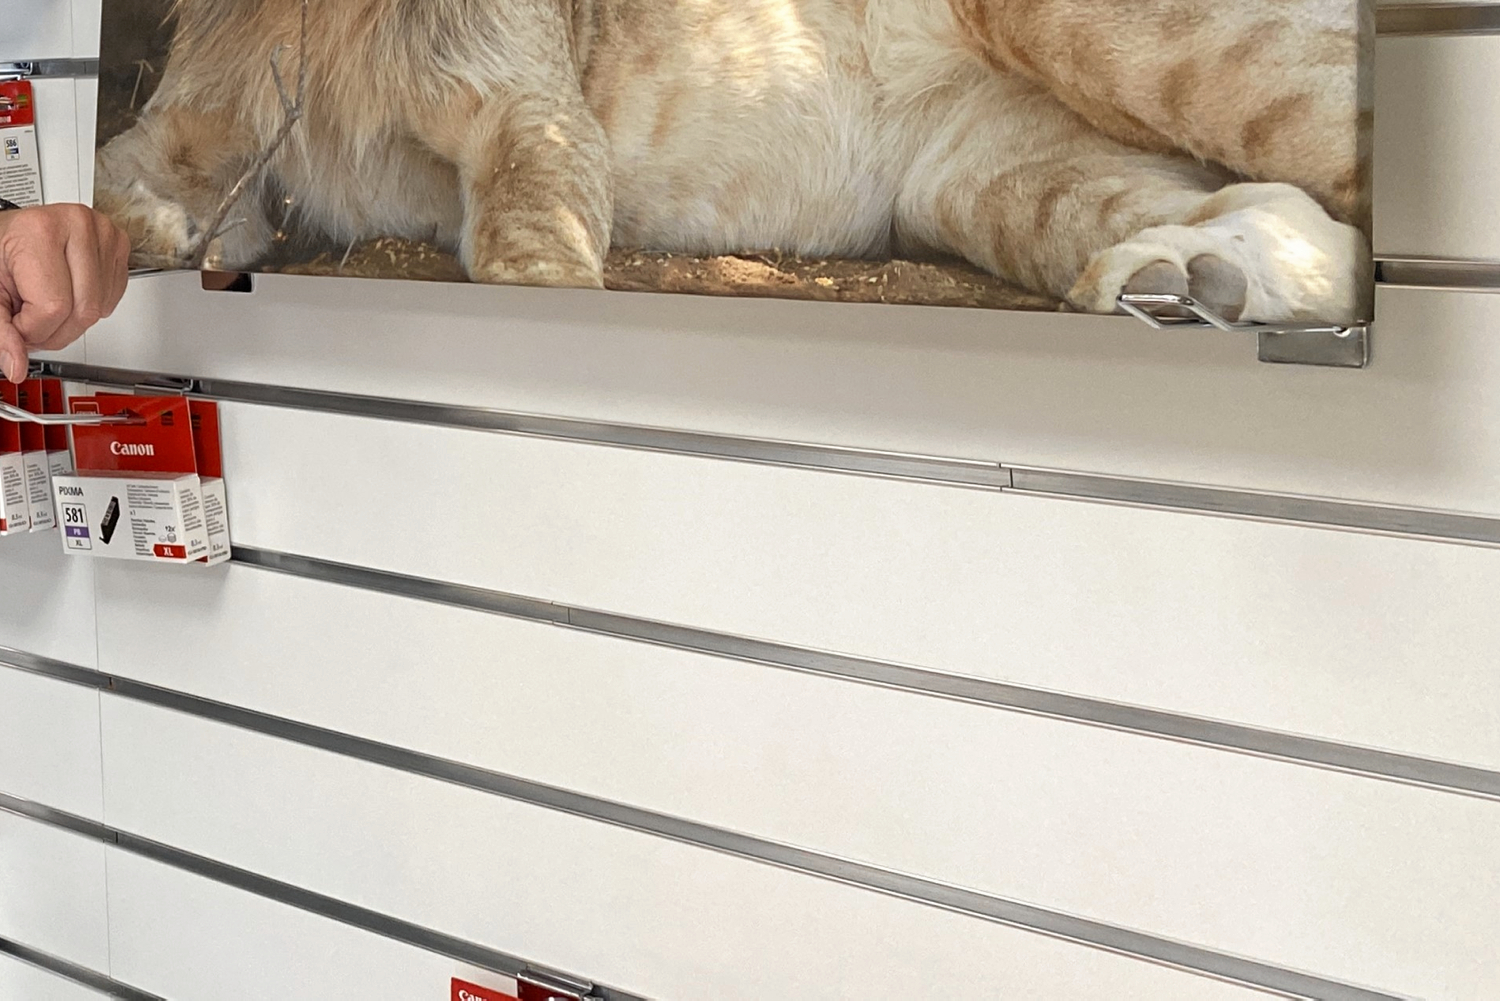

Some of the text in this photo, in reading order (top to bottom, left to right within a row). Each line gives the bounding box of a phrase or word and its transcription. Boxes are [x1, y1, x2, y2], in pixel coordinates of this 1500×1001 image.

[6, 139, 18, 148] 586
[110, 441, 154, 456] Canon
[58, 486, 84, 496] PIXMA
[65, 508, 84, 523] 581
[74, 528, 82, 536] PB
[163, 547, 174, 556] XL
